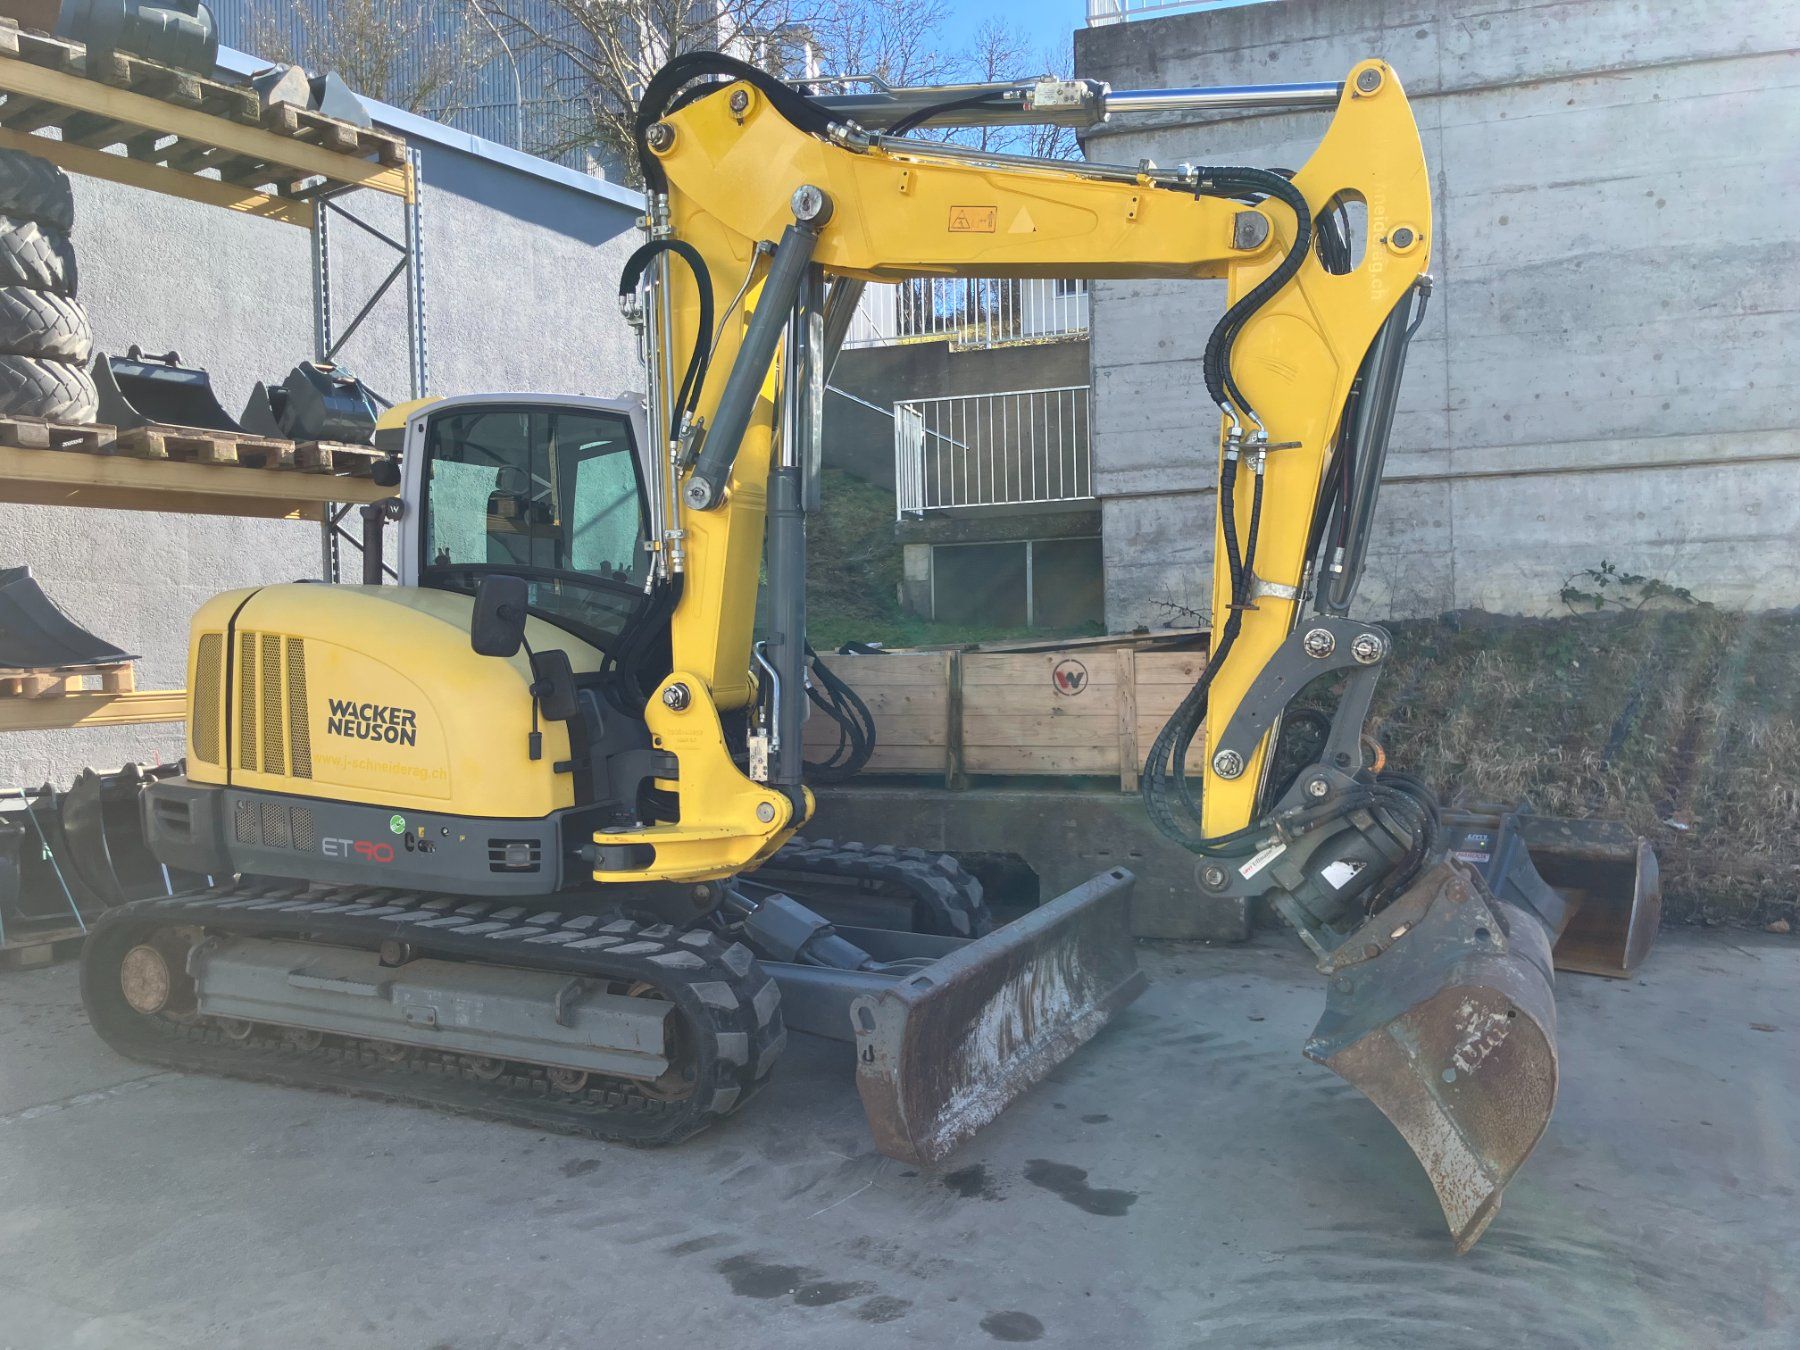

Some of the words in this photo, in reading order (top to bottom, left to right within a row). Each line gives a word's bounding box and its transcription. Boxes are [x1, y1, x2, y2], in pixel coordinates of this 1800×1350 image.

[328, 698, 417, 728] WACKER
[327, 716, 417, 747] NEUSON
[313, 753, 447, 781] www.j-schneiderag.ch
[322, 837, 395, 863] ET90
